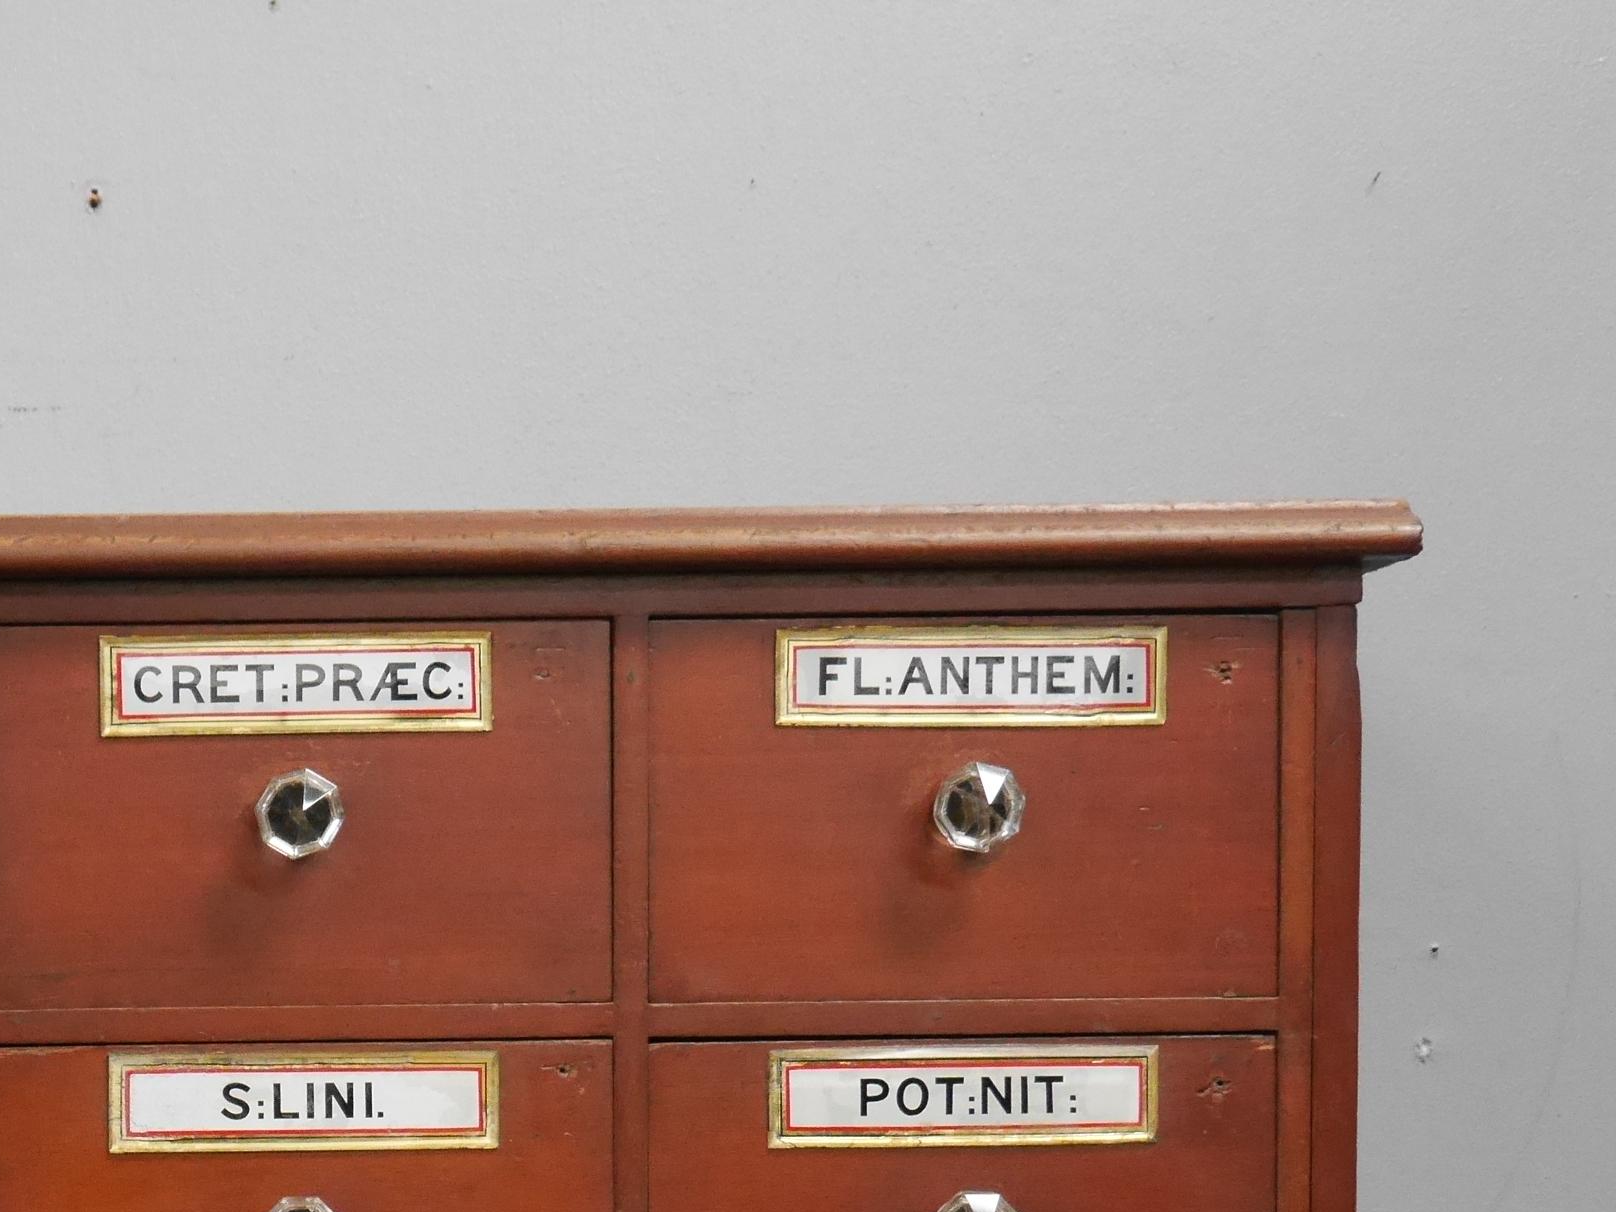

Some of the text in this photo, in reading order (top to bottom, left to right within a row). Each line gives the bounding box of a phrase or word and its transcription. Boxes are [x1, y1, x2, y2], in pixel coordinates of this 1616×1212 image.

[133, 661, 464, 704] CRET:PRÆC:
[818, 655, 1134, 696] FL:ANTHEM:
[220, 1082, 384, 1120] S:LINI.
[859, 1075, 1077, 1117] POT:NIT:
